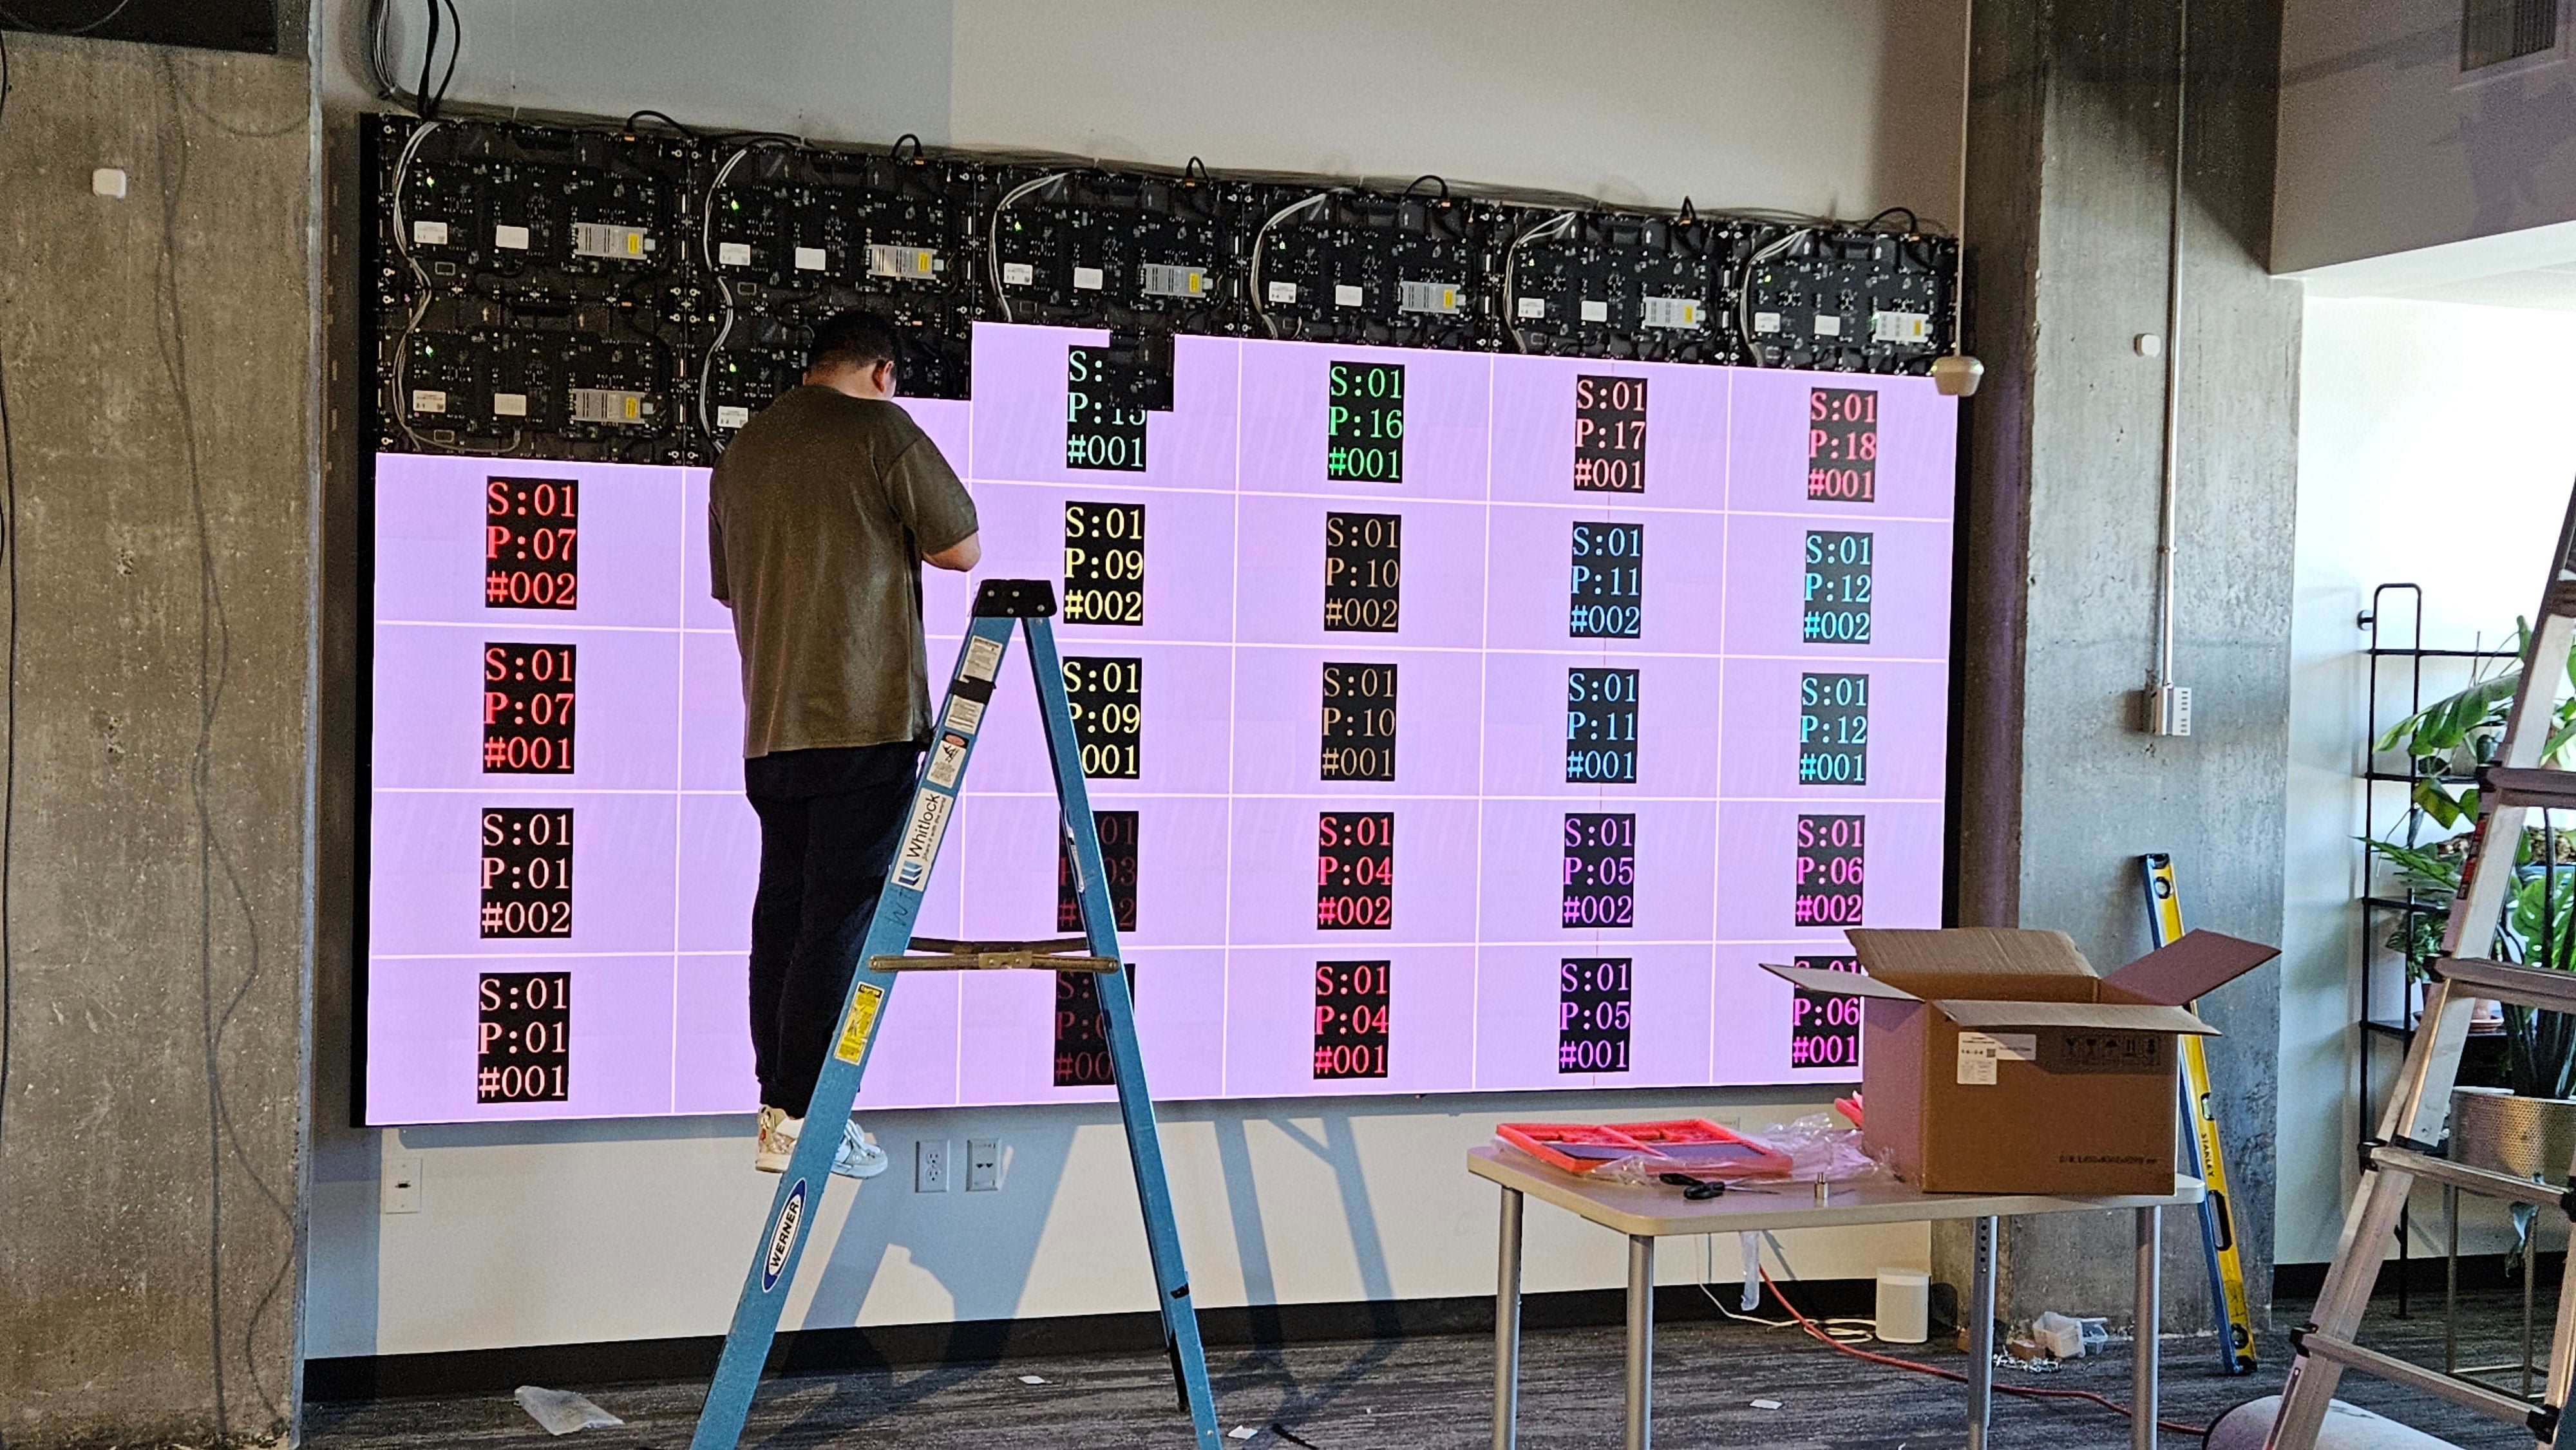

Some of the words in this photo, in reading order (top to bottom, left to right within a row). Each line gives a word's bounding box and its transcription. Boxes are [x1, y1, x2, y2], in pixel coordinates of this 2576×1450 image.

[1331, 366, 1401, 399] S:01
[1577, 379, 1645, 411] S:01
[1329, 406, 1403, 439] P:16
[1811, 391, 1876, 424] S:01
[1576, 418, 1645, 450] P:17
[1810, 428, 1875, 462] P:18
[1067, 433, 1144, 467] #001
[1329, 447, 1399, 479] #001
[1575, 458, 1642, 489] #001
[1809, 467, 1873, 499] #001
[488, 482, 575, 518] S:01
[1065, 506, 1143, 540] S:01
[1327, 518, 1397, 548] S:01
[487, 525, 576, 561] P:07
[1573, 526, 1641, 557] S:01
[1806, 535, 1871, 565] S:01
[1064, 547, 1144, 579] P:09
[1327, 558, 1399, 588] P:10
[486, 570, 576, 605] #002
[1571, 565, 1640, 596] P:11
[1804, 572, 1871, 603] P:12
[1065, 588, 1142, 622] #002
[1325, 598, 1397, 628] #002
[1571, 604, 1640, 635] #002
[1804, 610, 1870, 641] #002
[485, 647, 573, 682] S:01
[1063, 661, 1139, 693] S:01
[1323, 668, 1393, 697] S:01
[1569, 673, 1636, 702] S:01
[1803, 675, 1867, 708] S:01
[484, 692, 574, 726] P:07
[1323, 707, 1396, 737] P:10
[1567, 711, 1636, 741] P:11
[1801, 715, 1866, 745] P:12
[484, 736, 571, 769] #001
[1081, 744, 1137, 775] 001
[1322, 748, 1390, 777] #001
[1567, 750, 1634, 779] #001
[1801, 752, 1865, 782] #001
[482, 813, 570, 847] S:01
[906, 793, 940, 858] Whitlock
[1320, 816, 1390, 847] S:01
[1565, 818, 1633, 847] S:01
[1798, 819, 1864, 849] S:01
[482, 857, 569, 889] P:01
[1319, 856, 1392, 886] P:04
[1564, 856, 1634, 886] P:05
[1796, 856, 1864, 886] P:06
[481, 901, 571, 933] #002
[1318, 896, 1390, 925] #002
[1563, 895, 1632, 924] #002
[1795, 894, 1862, 923] #002
[1316, 965, 1387, 996] S:01
[1562, 963, 1629, 993] S:01
[480, 977, 567, 1012] S:01
[1315, 1004, 1388, 1035] P:04
[1560, 1001, 1630, 1031] P:05
[1793, 997, 1860, 1027] P:06
[479, 1021, 566, 1054] P:01
[1792, 1035, 1857, 1064] #001
[1056, 1051, 1112, 1082] #00
[1314, 1044, 1385, 1075] #001
[1560, 1039, 1627, 1069] #001
[478, 1065, 565, 1098] #001
[2201, 1133, 2215, 1177] STANLEY
[770, 1200, 800, 1267] WERNER
